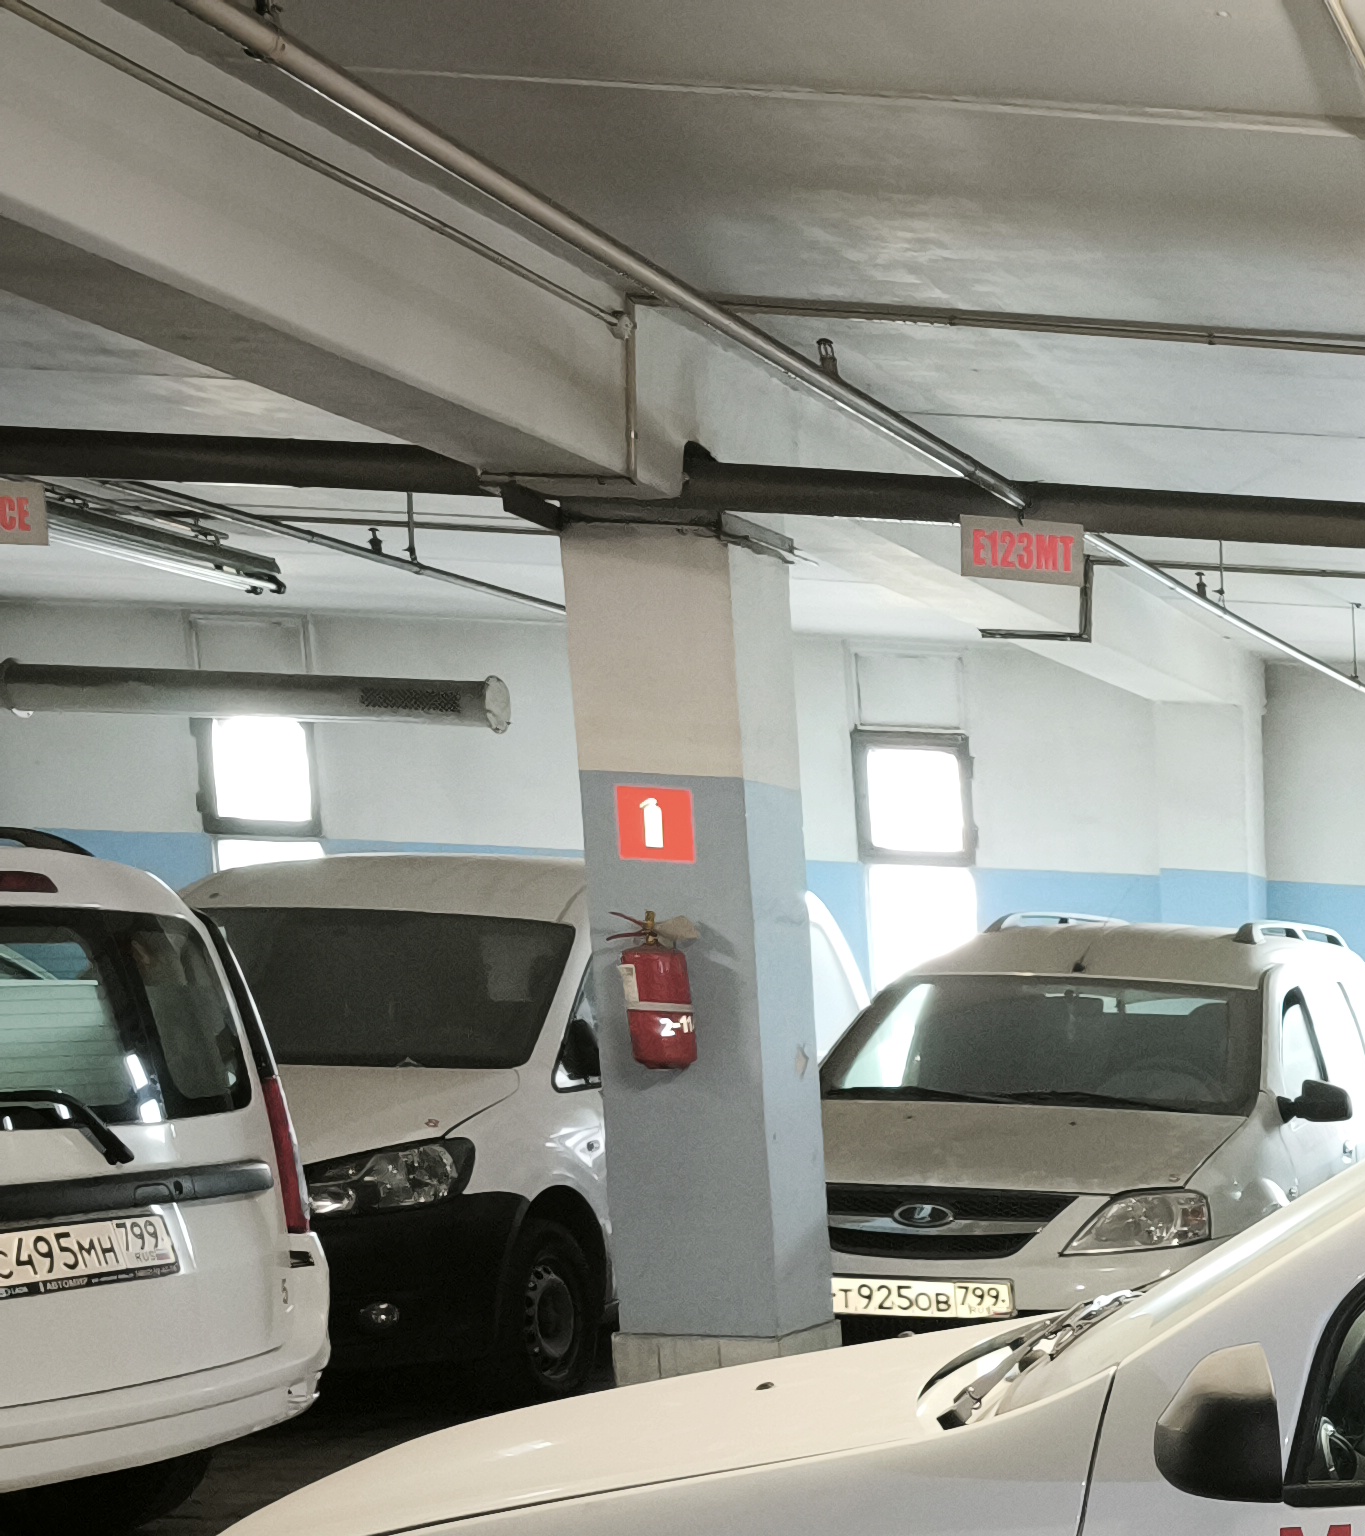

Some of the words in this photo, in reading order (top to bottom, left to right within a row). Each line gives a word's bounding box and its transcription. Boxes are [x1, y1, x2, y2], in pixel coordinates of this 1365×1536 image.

[973, 529, 1074, 573] Е123МТ
[659, 1015, 695, 1037] 2-11
[115, 1219, 159, 1252] 799
[135, 1250, 157, 1262] RUS
[838, 1283, 952, 1312] Т925ОВ
[956, 1285, 1000, 1307] 799
